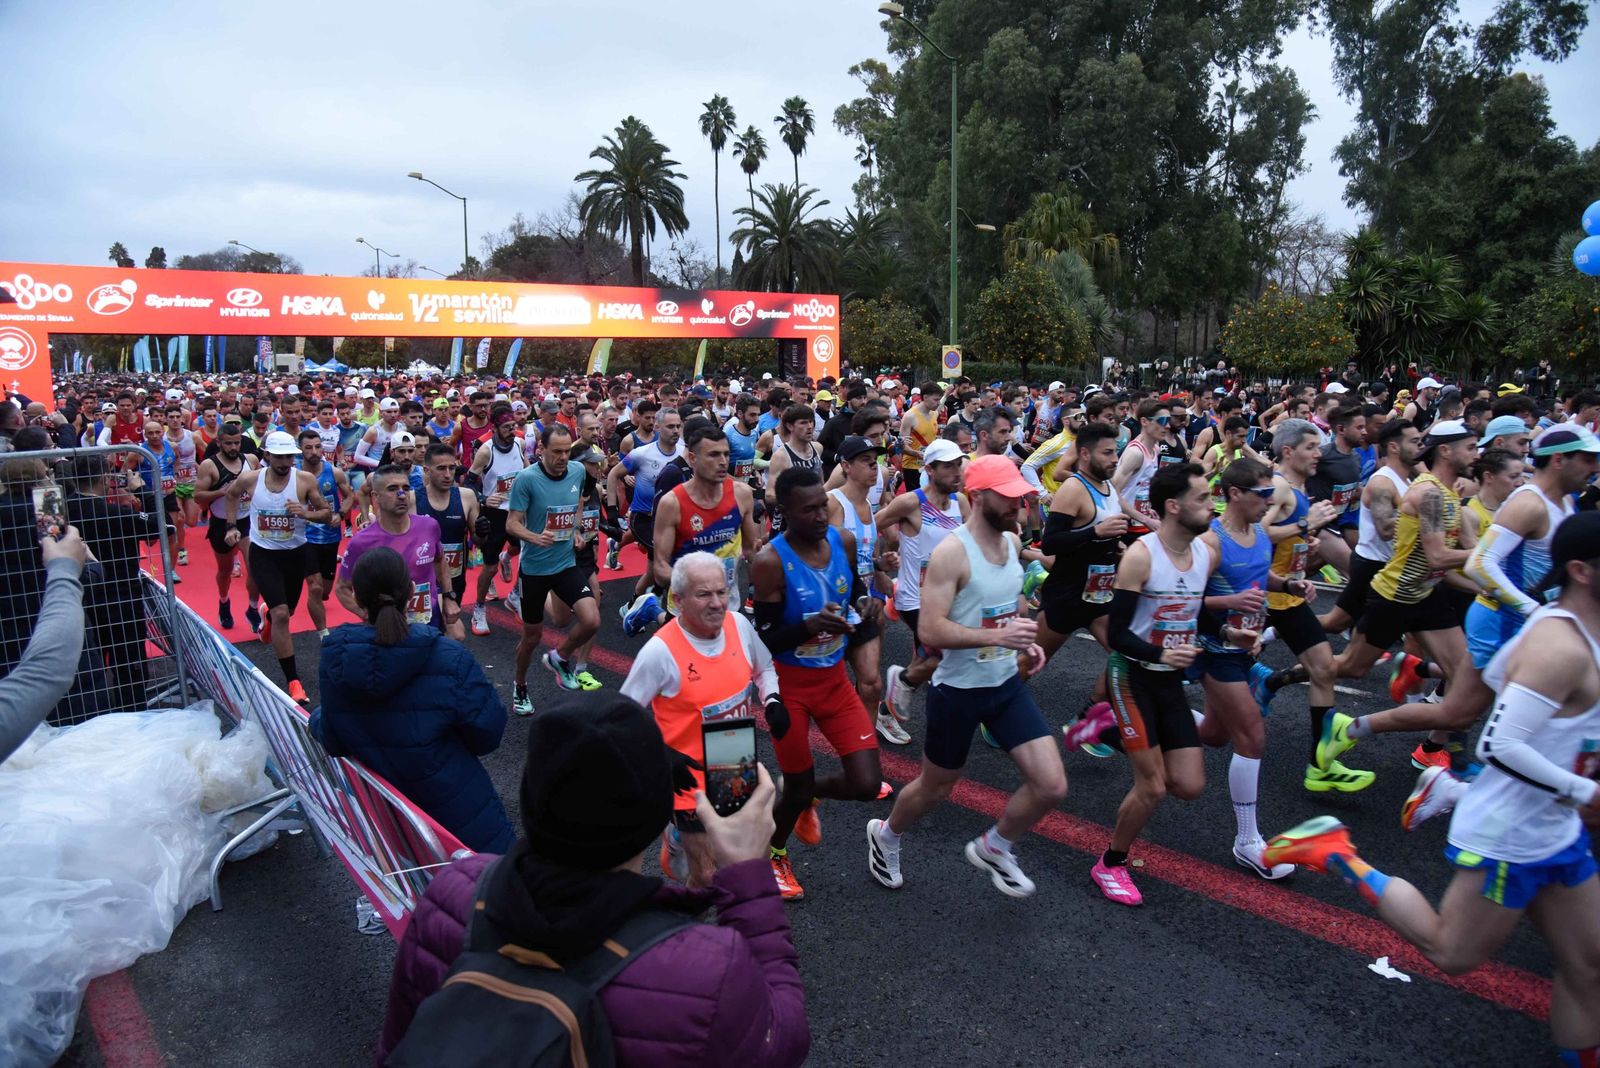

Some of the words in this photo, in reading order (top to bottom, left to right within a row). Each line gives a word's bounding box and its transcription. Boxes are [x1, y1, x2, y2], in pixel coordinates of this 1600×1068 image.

[145, 294, 213, 309] Sprinter
[281, 295, 346, 316] HOKA
[220, 307, 271, 318] HYUNDAI
[597, 303, 644, 320] HOKA
[756, 309, 791, 320] Sprinter
[652, 315, 683, 324] HYUNDAI
[264, 517, 289, 527] 1569
[555, 514, 574, 526] 1190
